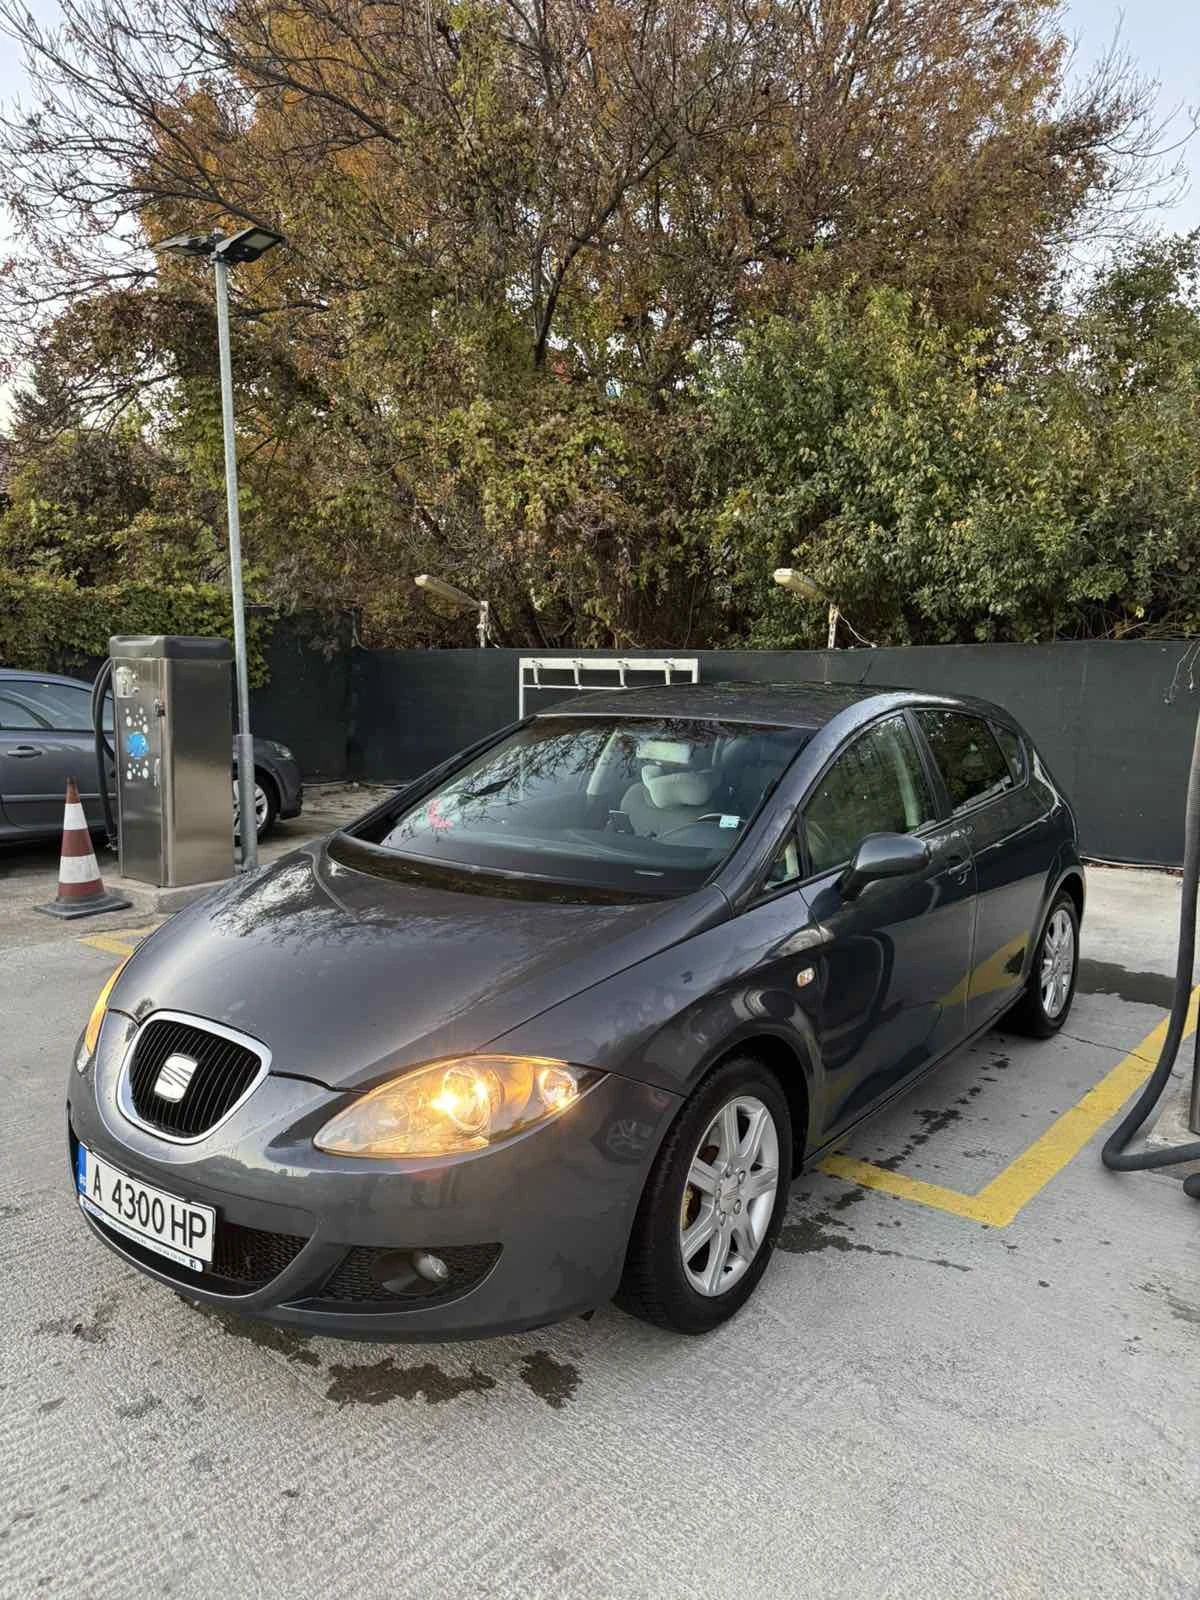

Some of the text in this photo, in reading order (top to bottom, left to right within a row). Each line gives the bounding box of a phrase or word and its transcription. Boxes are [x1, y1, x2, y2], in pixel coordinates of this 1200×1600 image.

[93, 1164, 102, 1201] A
[112, 1178, 165, 1234] 4300
[171, 1204, 207, 1249] HP
